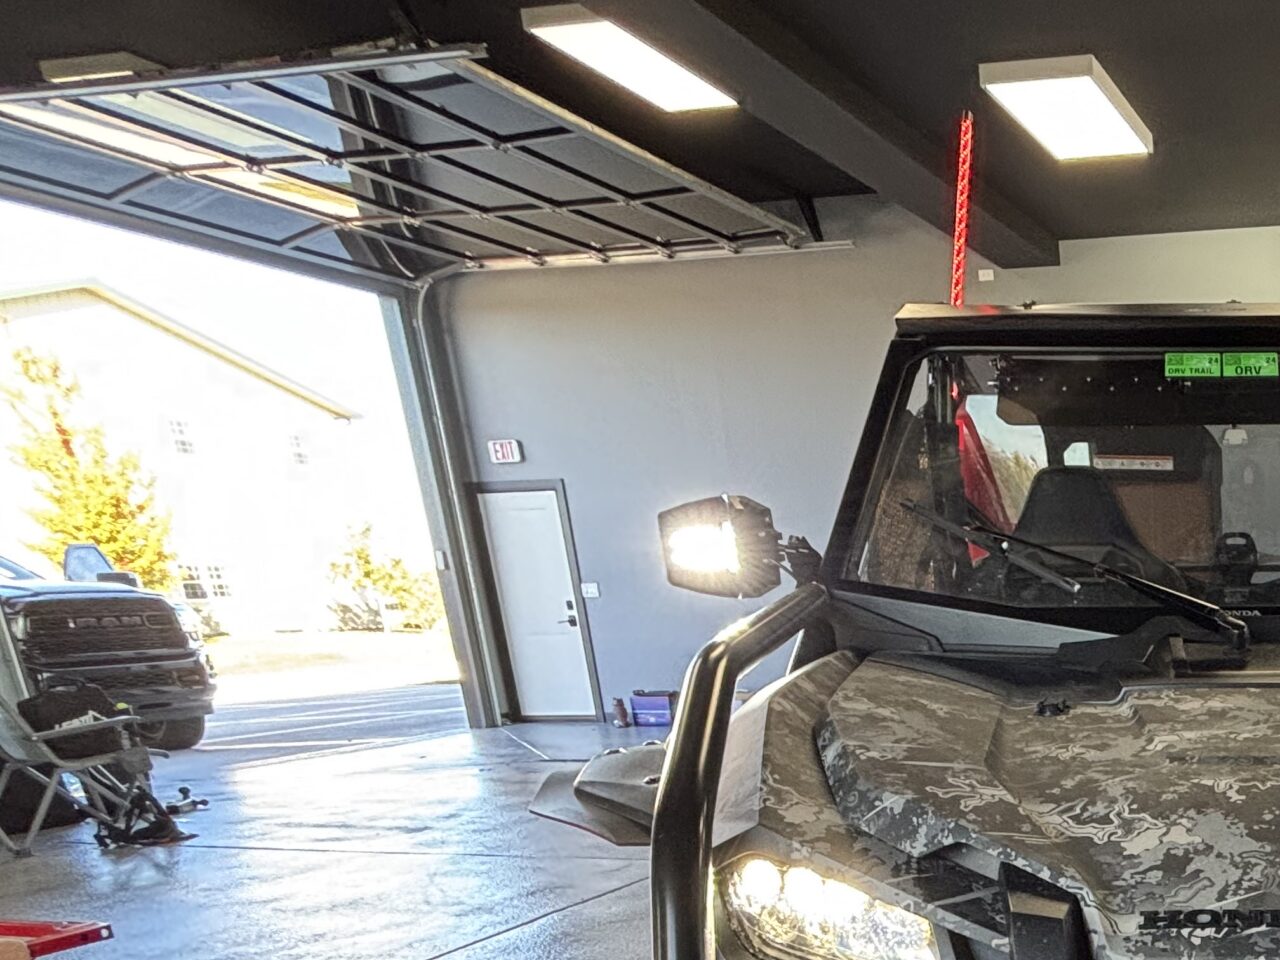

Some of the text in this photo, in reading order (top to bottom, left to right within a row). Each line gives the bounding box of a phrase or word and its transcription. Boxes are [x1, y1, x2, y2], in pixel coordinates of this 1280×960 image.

[1168, 367, 1215, 375] ORV TRAIL
[1234, 365, 1262, 375] ORV
[493, 441, 516, 461] EXIT
[1218, 609, 1262, 617] ONDA
[76, 616, 143, 629] RAM
